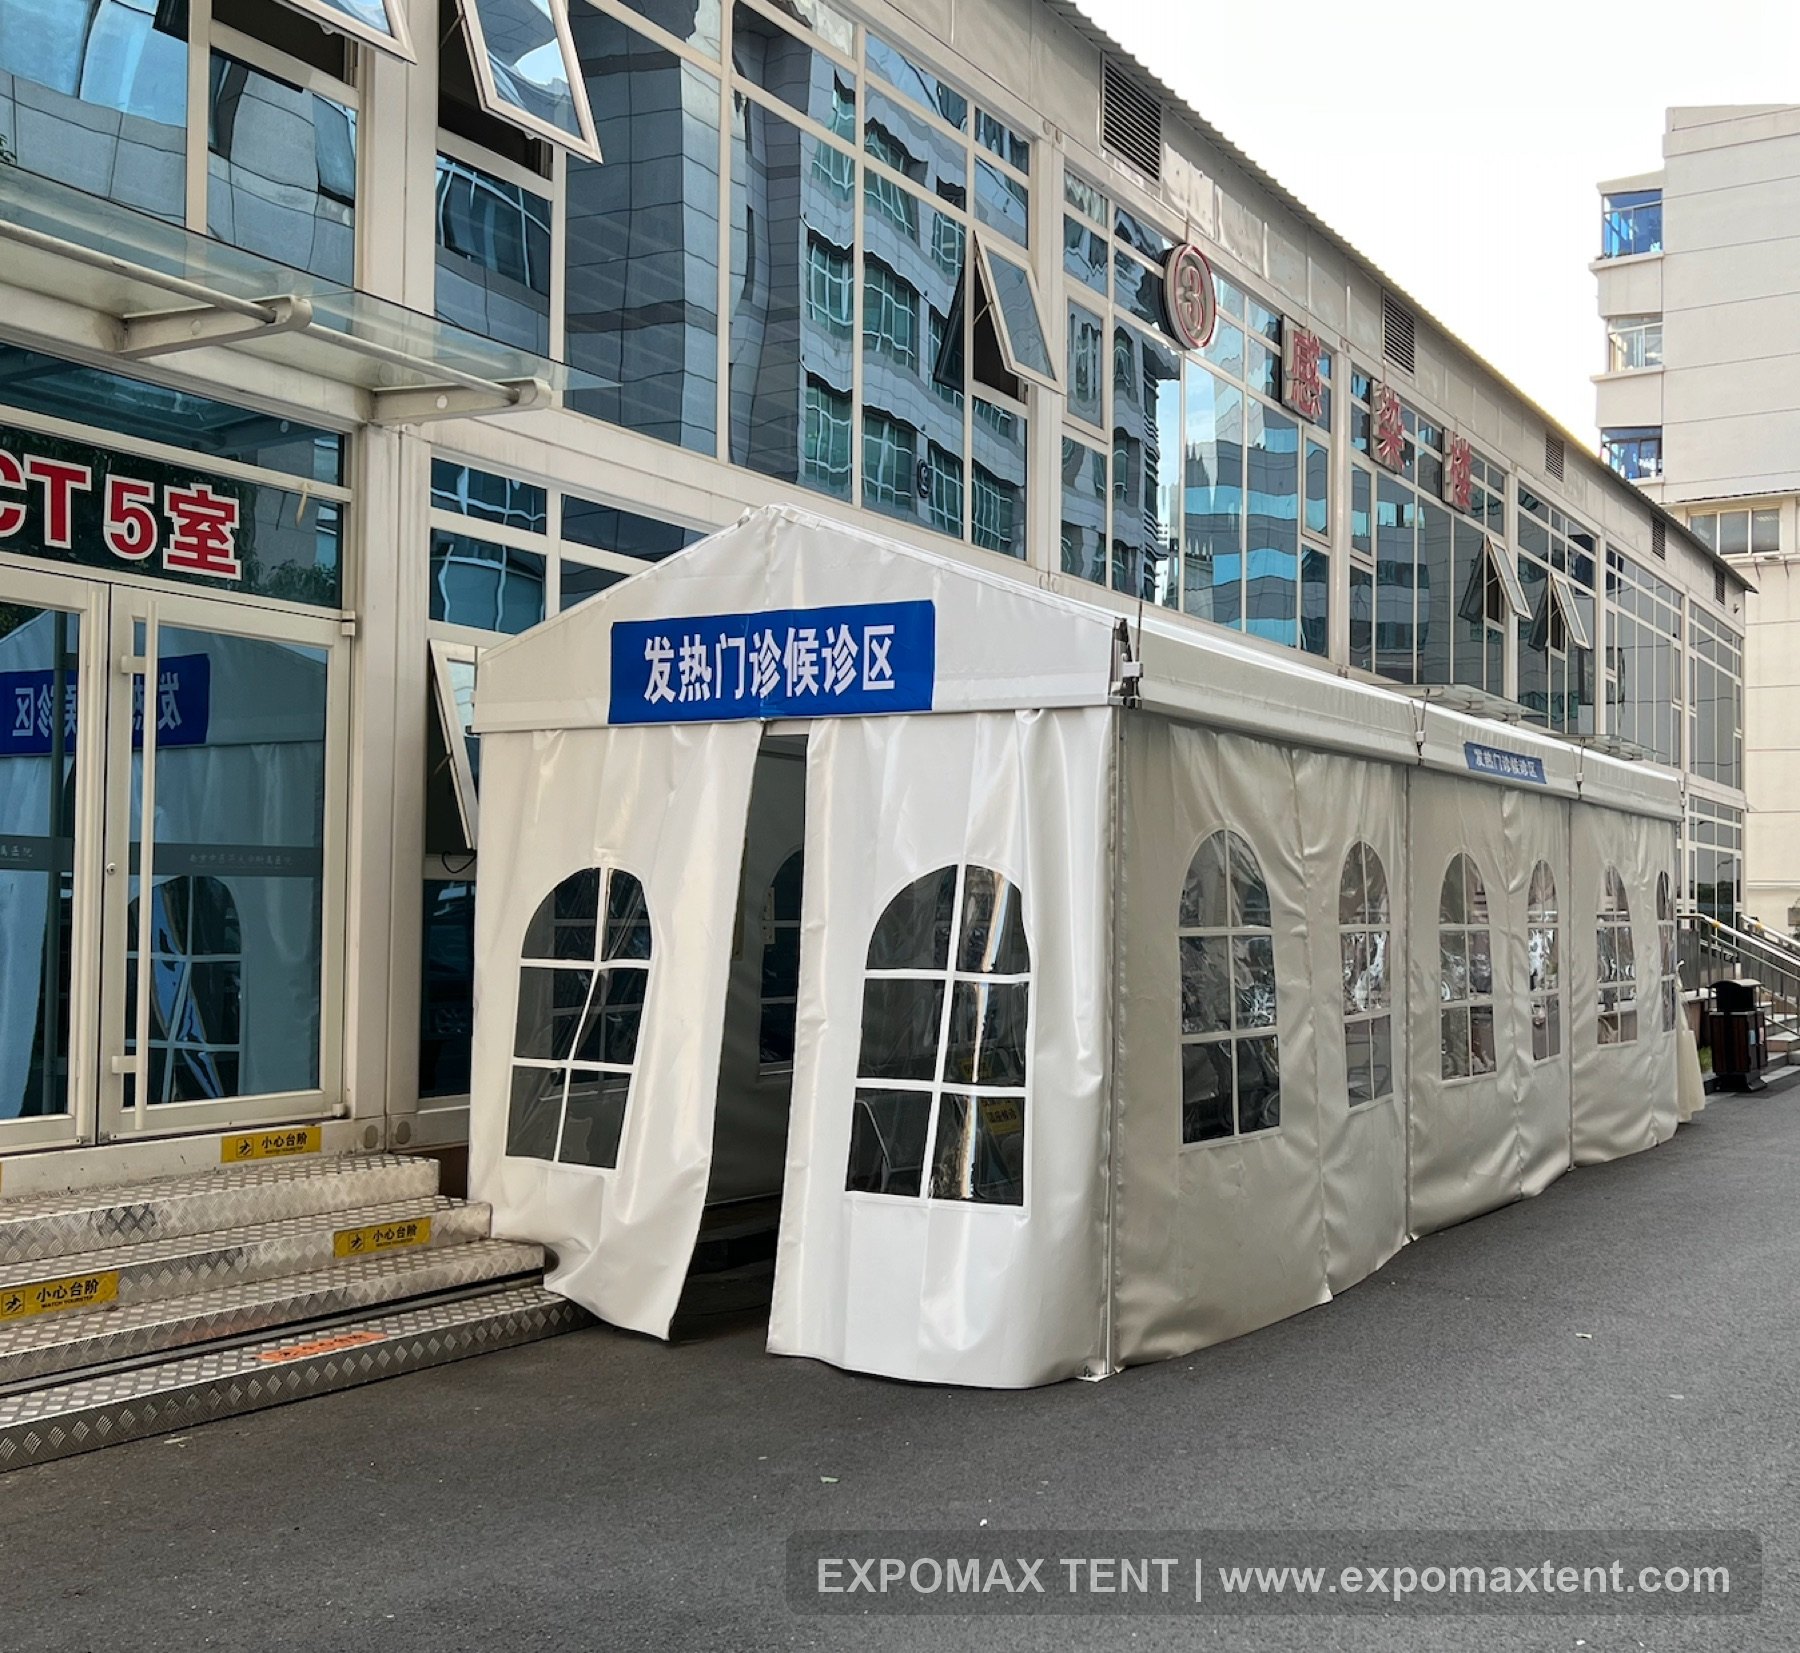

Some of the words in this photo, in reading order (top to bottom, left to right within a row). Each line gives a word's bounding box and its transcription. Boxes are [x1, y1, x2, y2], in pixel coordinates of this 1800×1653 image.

[643, 624, 895, 704] 发热门诊候诊区
[262, 1131, 307, 1148] 小心台阶
[373, 1224, 417, 1242] 小心台阶
[36, 1279, 99, 1302] 小心台阶
